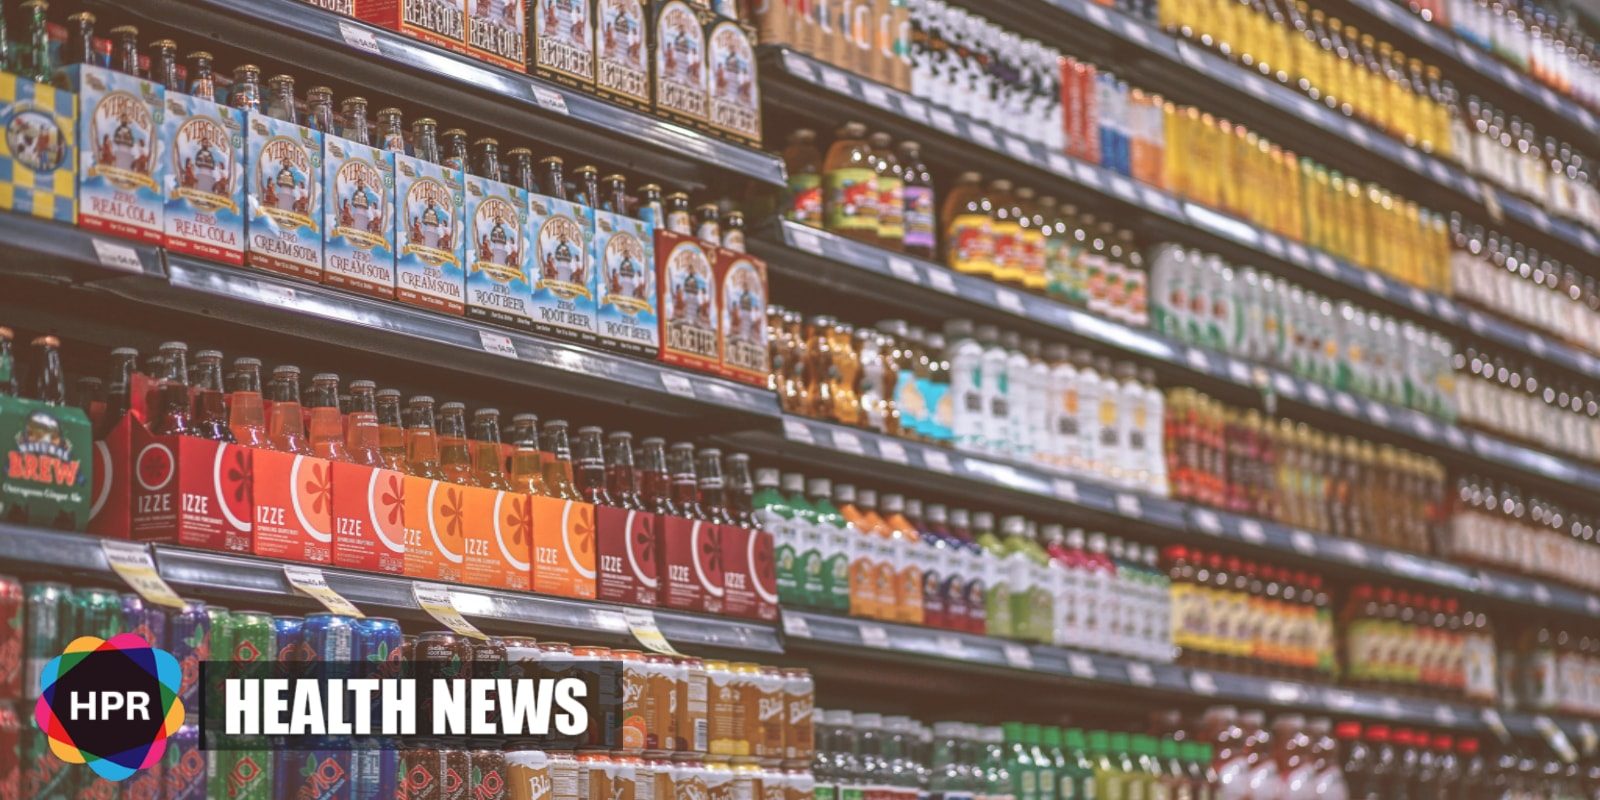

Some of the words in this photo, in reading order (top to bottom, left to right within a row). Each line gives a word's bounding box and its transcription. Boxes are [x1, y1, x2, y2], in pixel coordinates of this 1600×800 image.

[91, 197, 125, 219] REAL
[126, 203, 156, 226] COLA
[195, 213, 216, 226] ZERO
[174, 218, 206, 239] REAL
[207, 226, 236, 246] COLA
[254, 235, 292, 259] CREAM
[293, 244, 318, 262] SODA
[352, 251, 371, 262] ZERO
[330, 255, 365, 279] CREAM
[365, 263, 391, 282] SODA
[423, 267, 441, 278] ZERO
[401, 271, 436, 293] CREAM
[436, 279, 461, 298] SODA
[493, 284, 510, 295] ZERO
[475, 291, 501, 308] ROOT
[503, 297, 527, 315] BEER
[557, 300, 576, 311] ZERO
[540, 307, 566, 323] ROOT
[567, 312, 592, 330] BEER
[606, 321, 630, 337] ROOT
[631, 326, 654, 342] BEER
[8, 449, 81, 487] BREW
[138, 493, 171, 513] IZZE
[182, 493, 208, 514] IZZE
[257, 505, 285, 525] IZZE
[337, 517, 362, 537] IZZE
[404, 528, 422, 547] ZZE
[464, 538, 488, 556] IZZE
[536, 547, 558, 564] IZZE
[601, 555, 622, 573] IZZE
[668, 565, 690, 583] IZZE
[725, 572, 746, 590] IZZE
